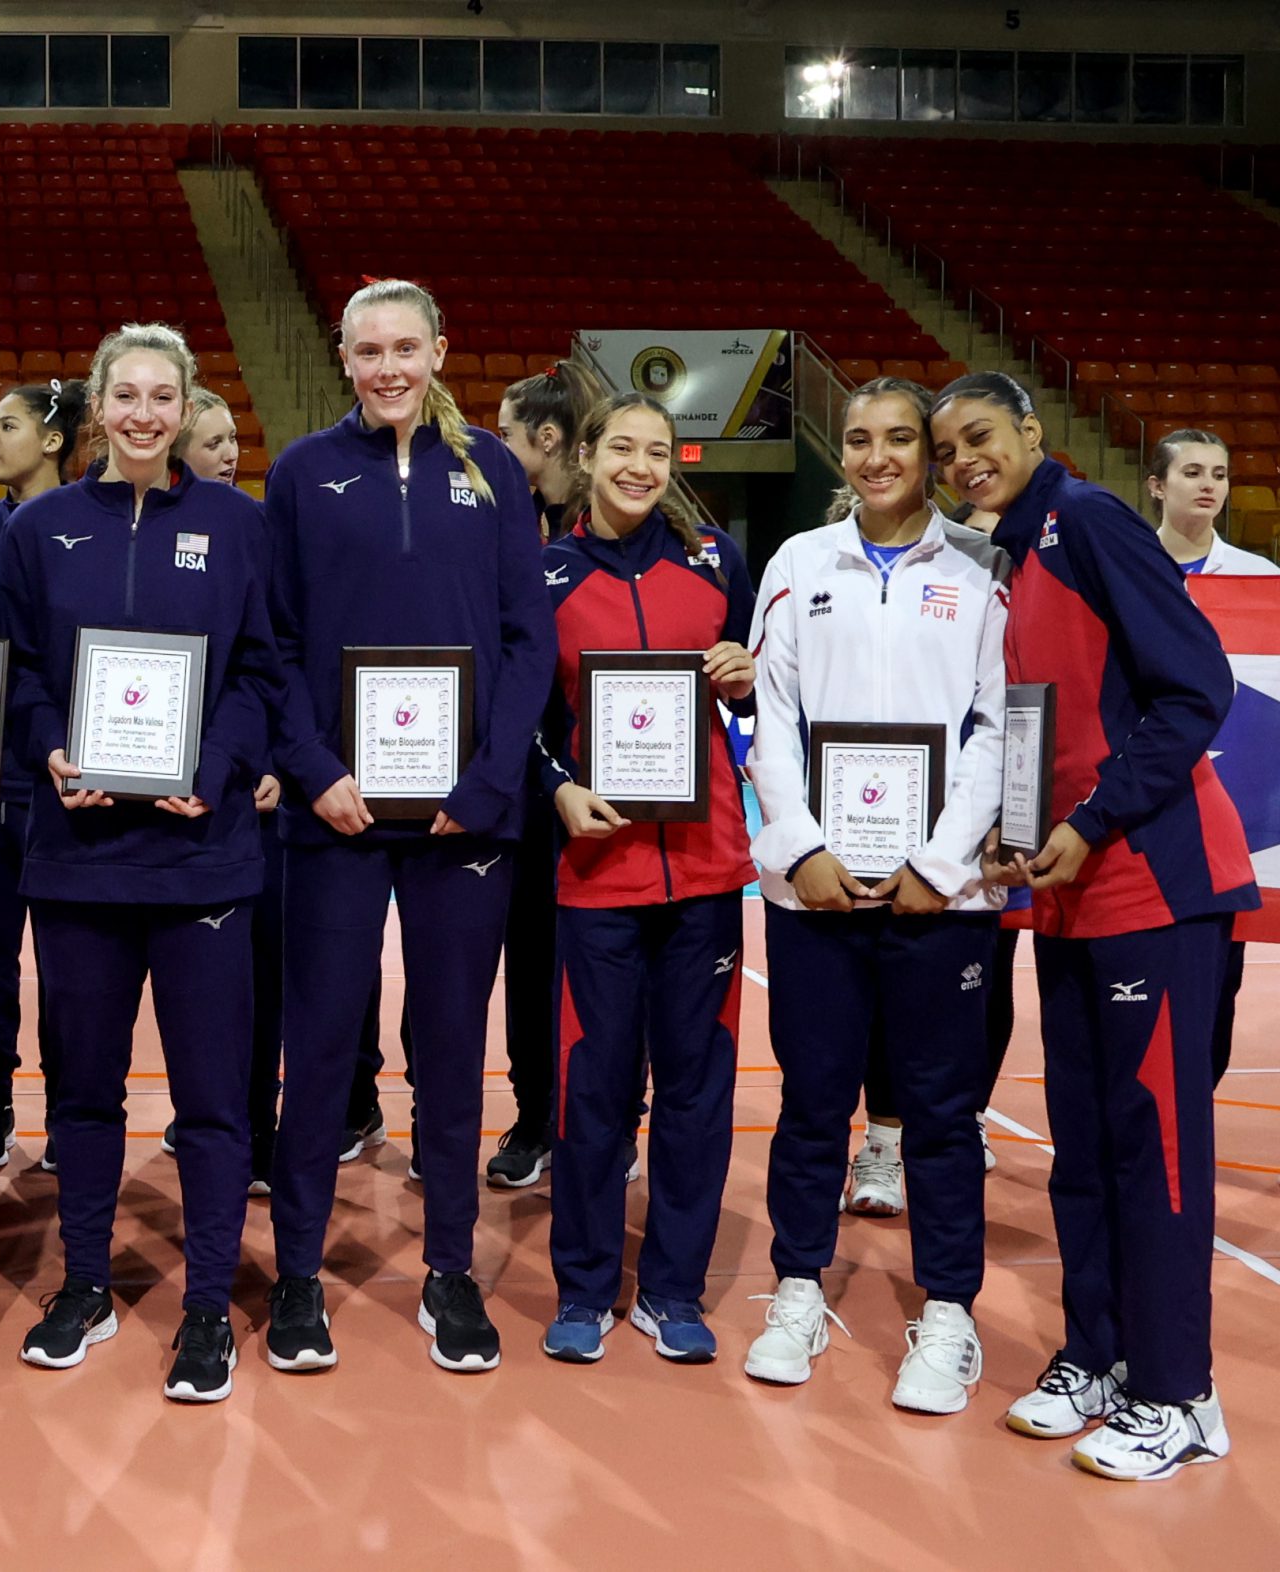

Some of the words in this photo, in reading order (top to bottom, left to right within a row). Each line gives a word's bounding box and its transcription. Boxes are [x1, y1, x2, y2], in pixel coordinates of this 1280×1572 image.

[1006, 9, 1020, 30] 5
[681, 444, 702, 462] EXIT
[450, 488, 478, 509] USA
[174, 551, 207, 572] USA
[809, 606, 832, 618] errea
[920, 604, 956, 622] PUR
[379, 737, 397, 749] Mejor
[615, 739, 633, 751] Mejor
[847, 814, 865, 826] Mejor
[866, 815, 900, 825] Atacadora
